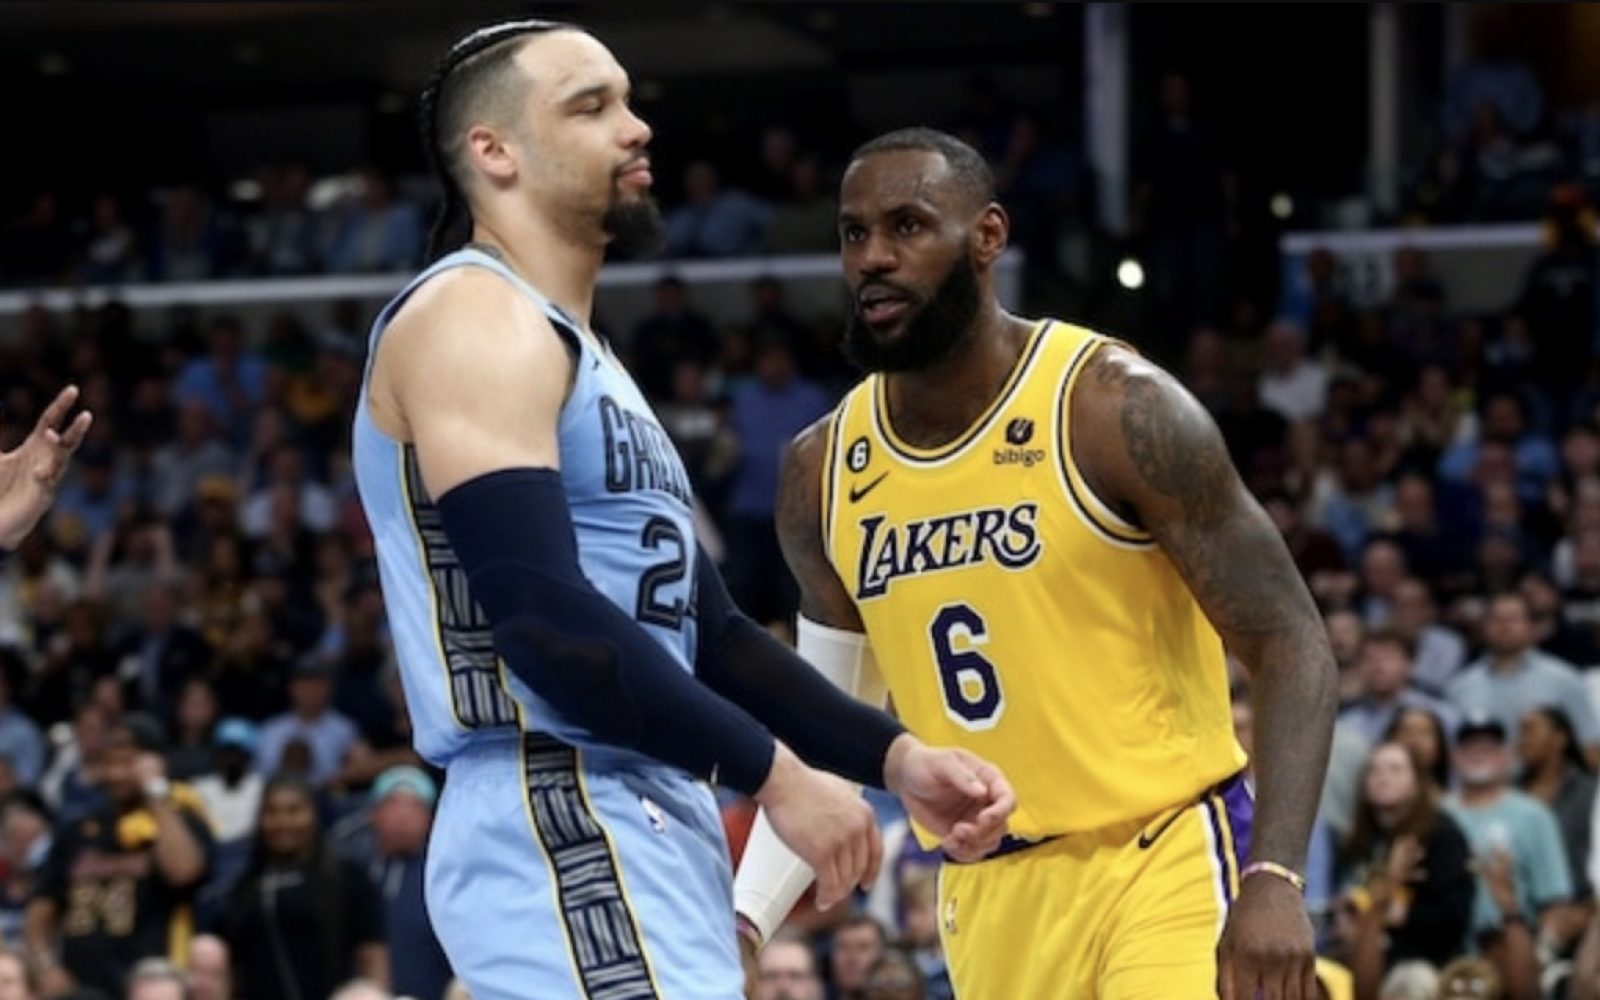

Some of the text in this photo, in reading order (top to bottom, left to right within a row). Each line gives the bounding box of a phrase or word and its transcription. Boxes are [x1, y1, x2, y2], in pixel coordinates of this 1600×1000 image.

[852, 440, 868, 471] 6
[993, 449, 1045, 468] bibigo
[856, 502, 1042, 600] LAKERS
[929, 602, 1004, 728] 6
